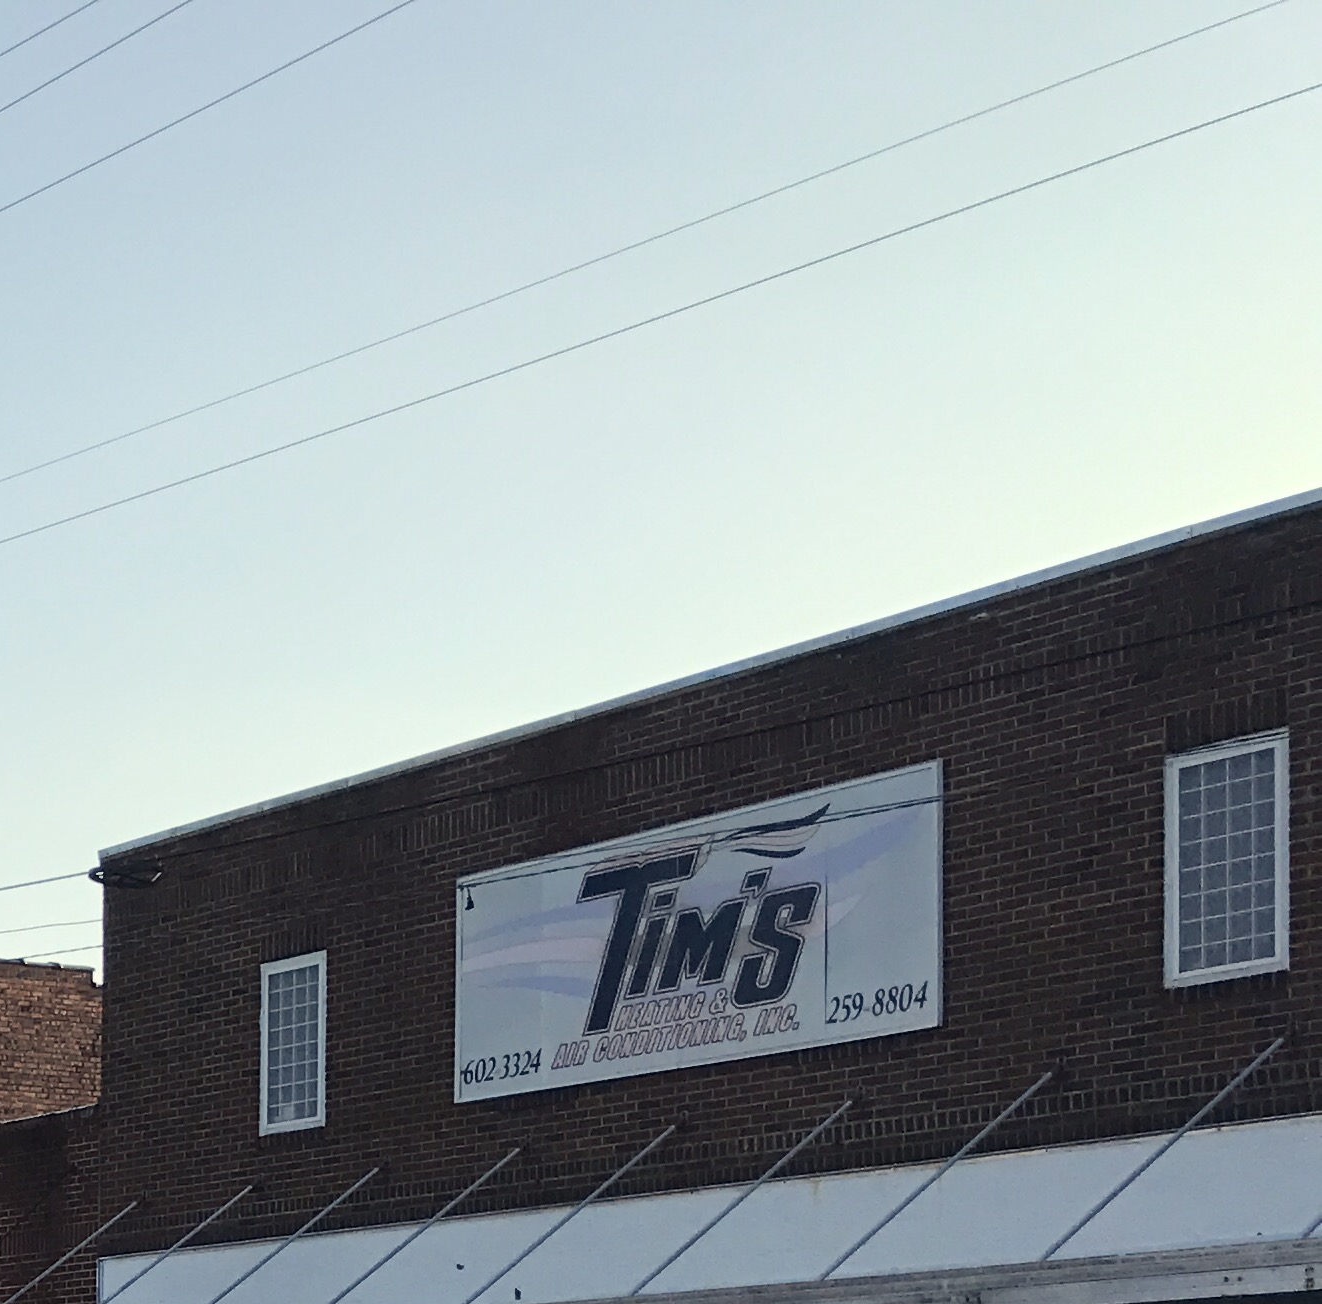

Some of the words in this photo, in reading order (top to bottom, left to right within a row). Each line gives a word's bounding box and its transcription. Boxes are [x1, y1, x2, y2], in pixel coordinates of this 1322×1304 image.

[550, 1039, 590, 1069] AIR
[592, 1013, 747, 1063] CONDITIONING,
[752, 1003, 800, 1037] INC.
[613, 991, 706, 1032] HEATING
[708, 988, 729, 1015] &
